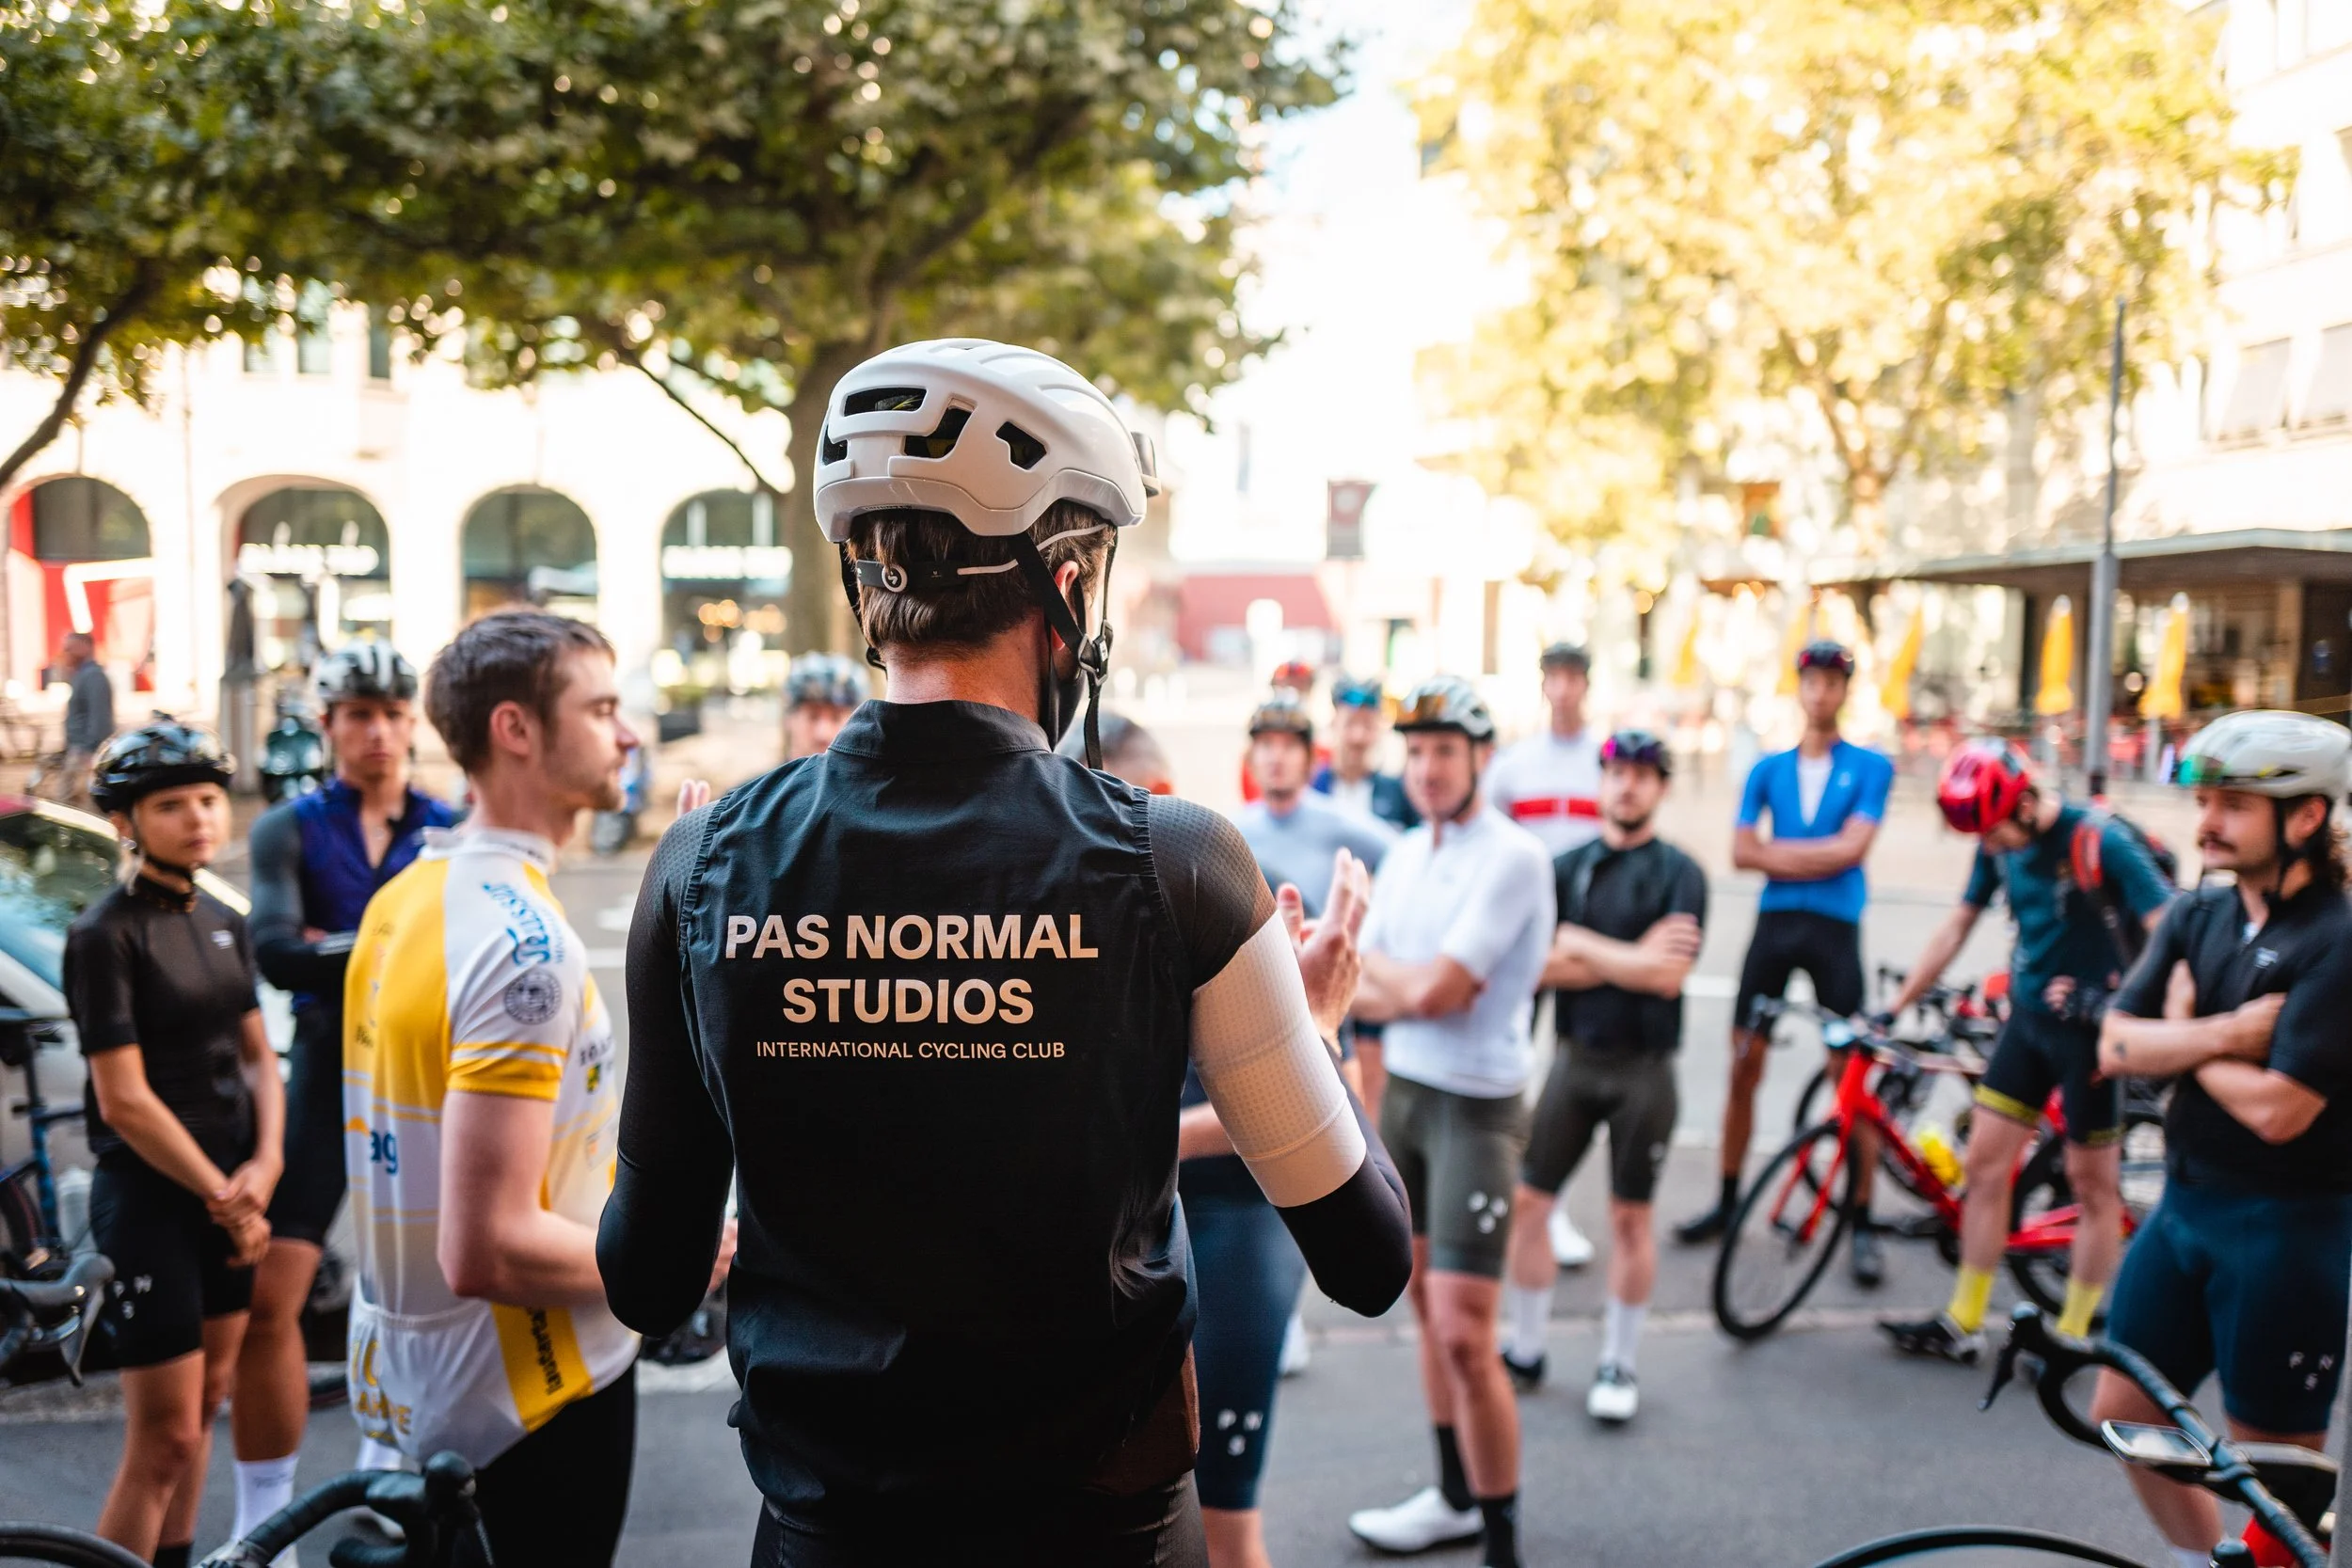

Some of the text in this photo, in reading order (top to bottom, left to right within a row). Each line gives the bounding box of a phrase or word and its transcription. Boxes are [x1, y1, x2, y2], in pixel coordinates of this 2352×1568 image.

[725, 913, 1099, 960] PAS NORMAL
[783, 978, 1034, 1024] STUDIOS
[756, 1041, 1065, 1059] INTERNATIONAL CYCLING CLUB
